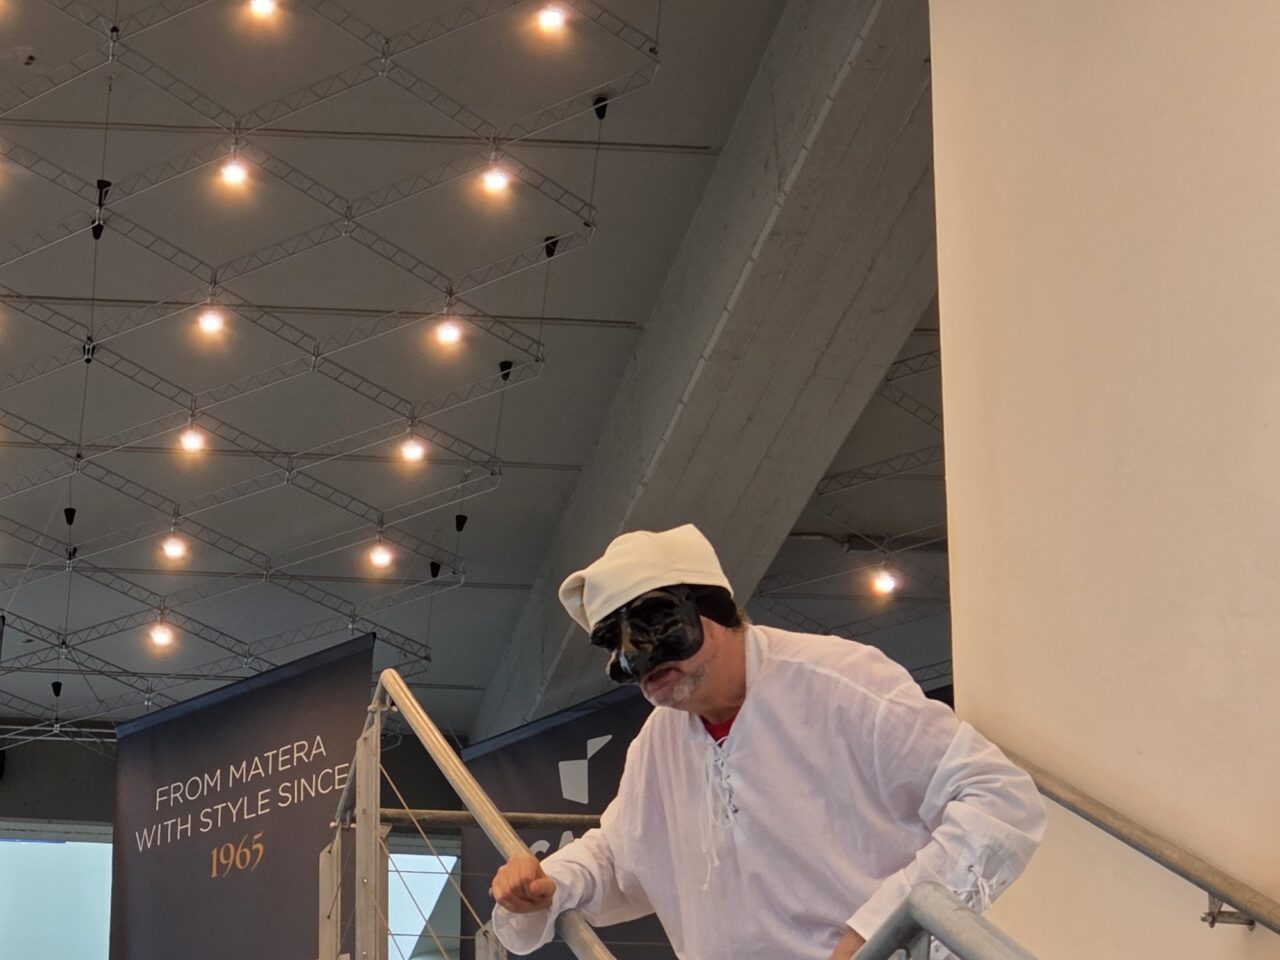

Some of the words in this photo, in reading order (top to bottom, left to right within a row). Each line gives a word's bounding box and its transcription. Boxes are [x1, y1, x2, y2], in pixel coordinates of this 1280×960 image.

[135, 814, 191, 852] WITH
[199, 789, 271, 832] STYLE
[278, 763, 350, 807] SINCE
[155, 769, 220, 811] FROM
[229, 735, 326, 787] MATERA
[210, 831, 264, 879] 1965
